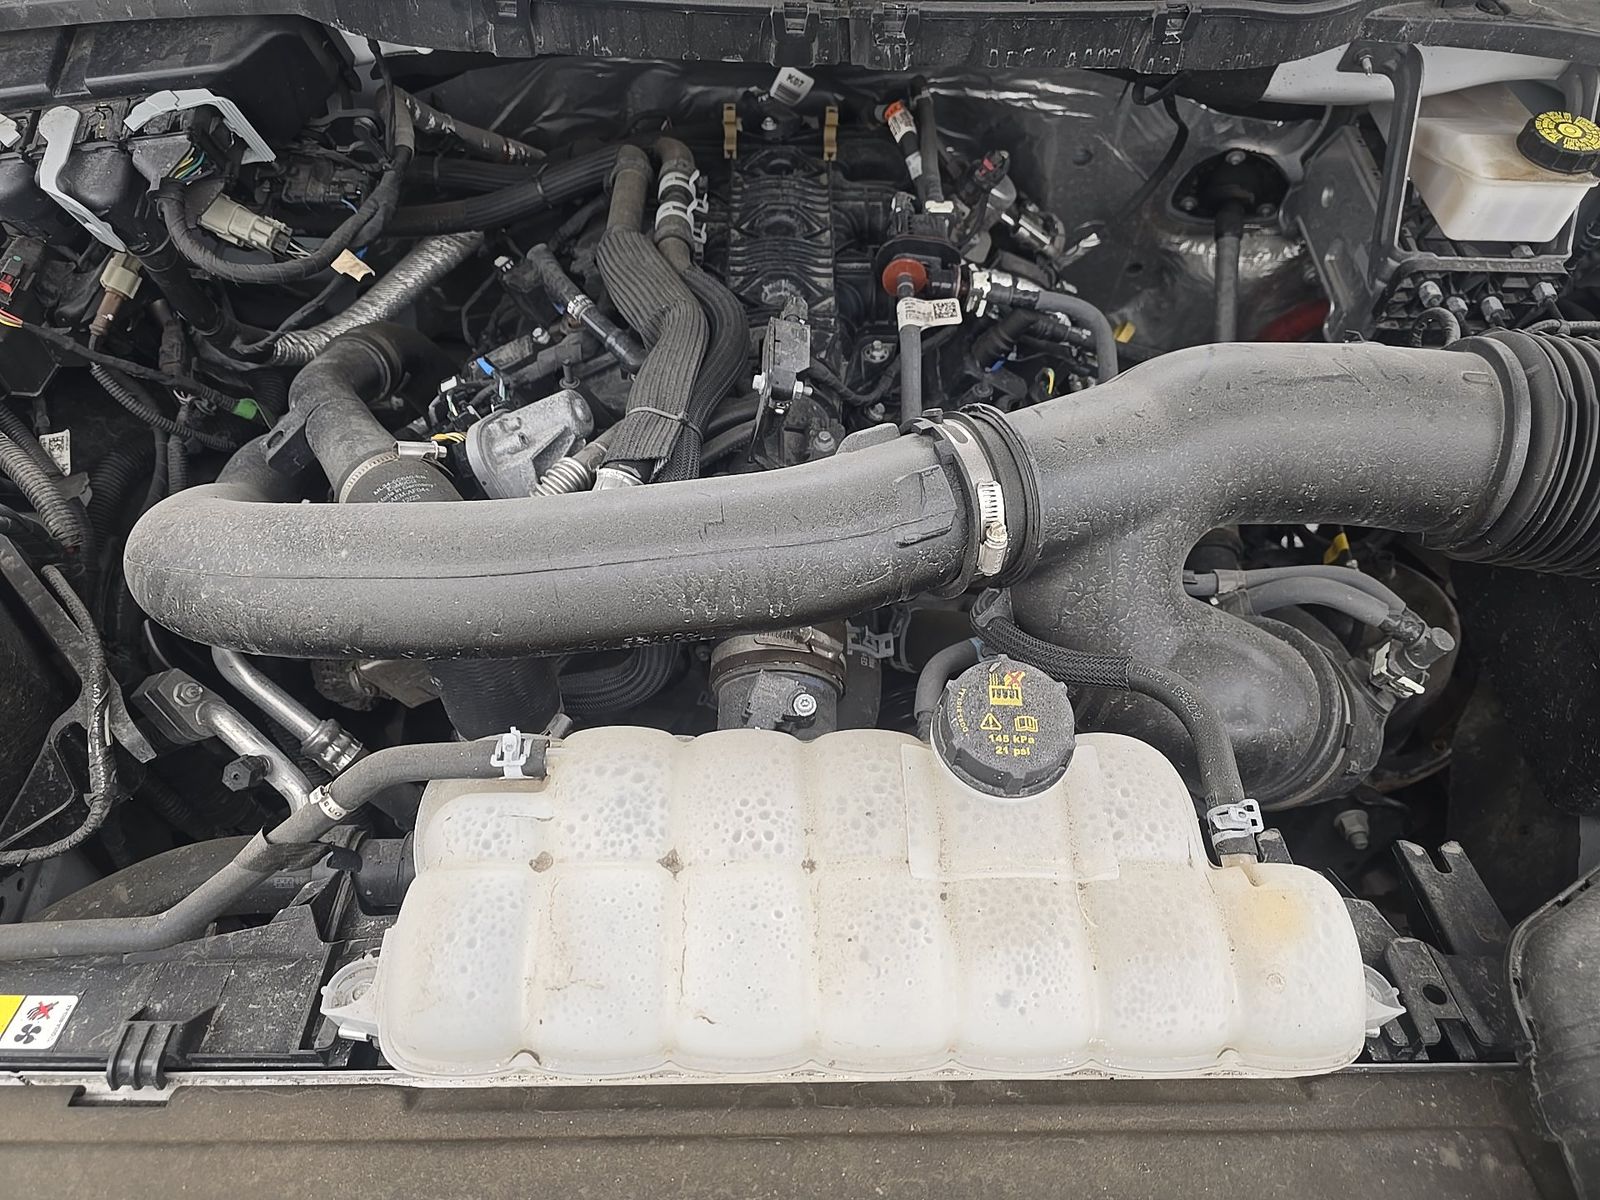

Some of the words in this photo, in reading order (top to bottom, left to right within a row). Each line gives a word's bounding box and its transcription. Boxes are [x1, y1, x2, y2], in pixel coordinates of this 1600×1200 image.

[988, 734, 1010, 743] 145
[1013, 734, 1035, 744] kPa
[995, 747, 1010, 755] 21
[1013, 747, 1031, 757] psi
